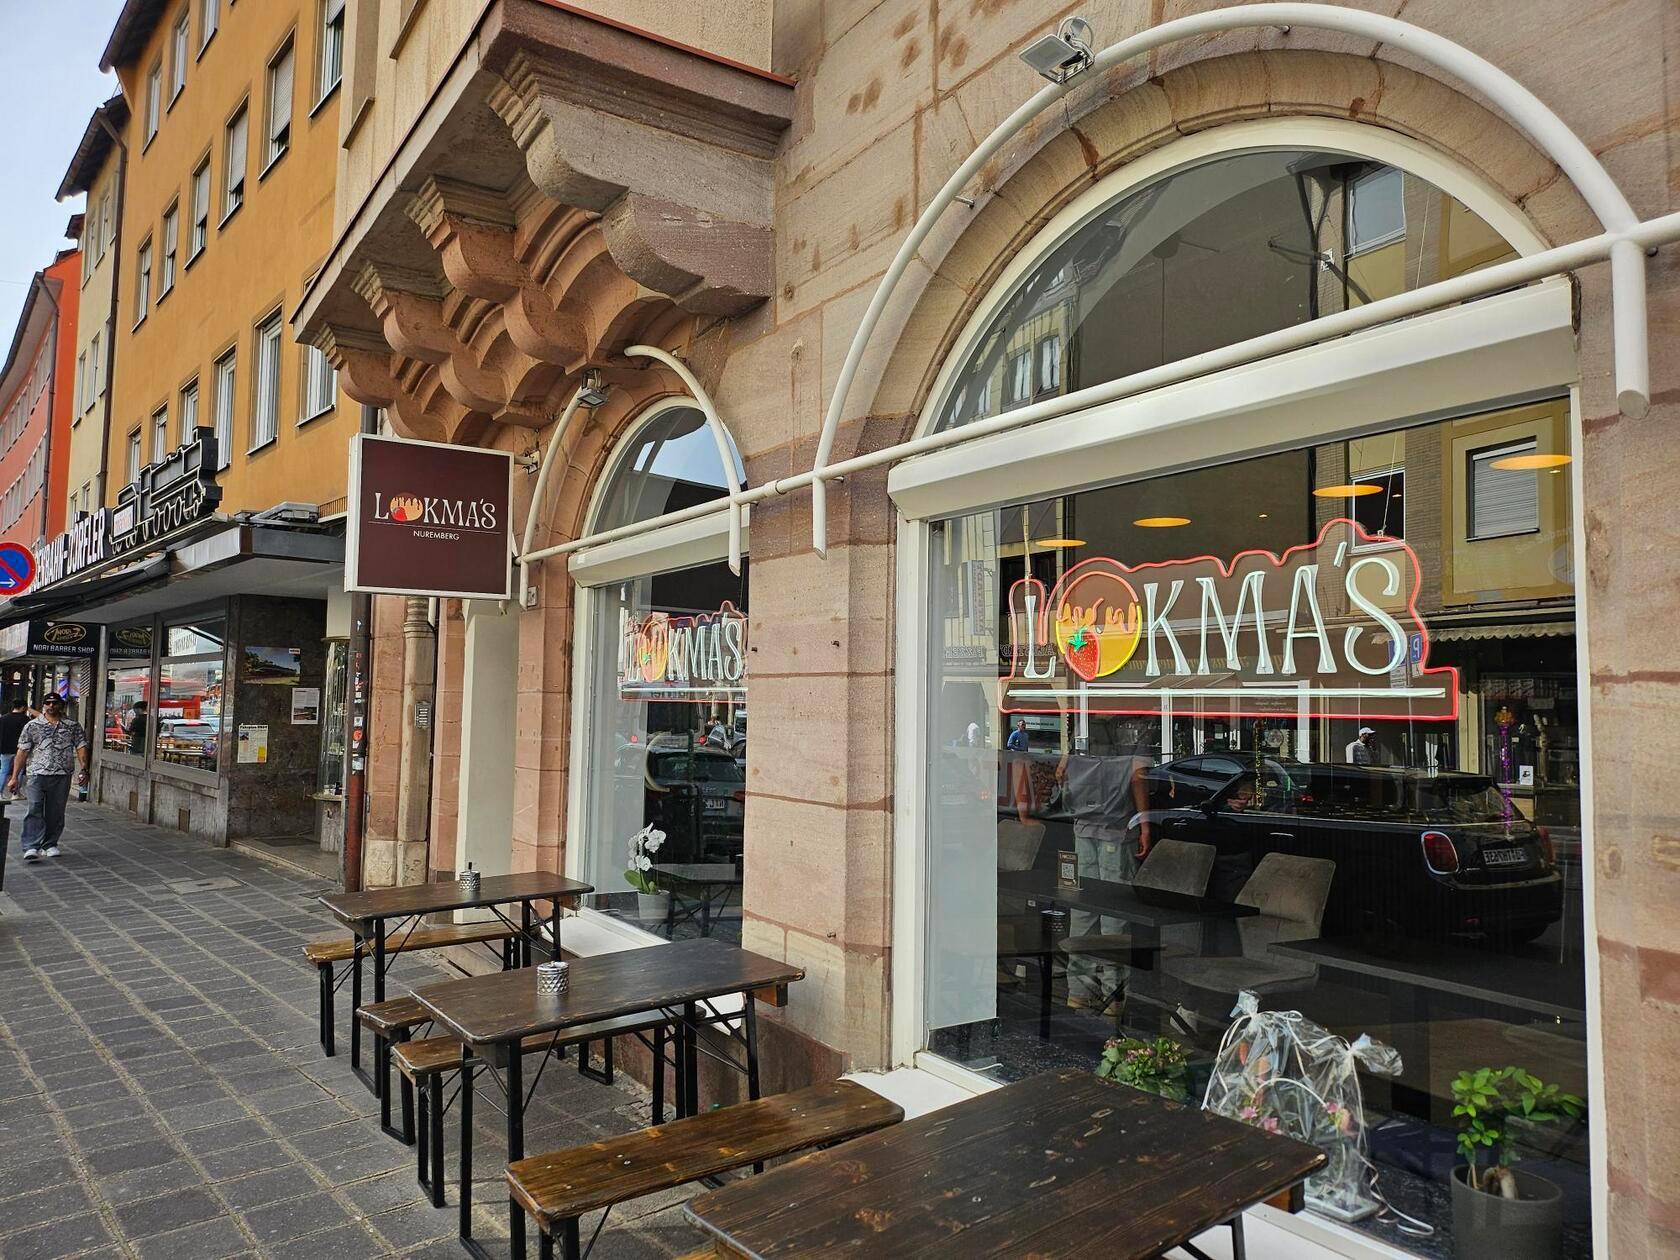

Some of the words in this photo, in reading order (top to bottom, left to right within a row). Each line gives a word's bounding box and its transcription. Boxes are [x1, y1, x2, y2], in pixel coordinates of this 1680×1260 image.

[413, 530, 460, 541] NUREMBERG
[33, 643, 49, 652] NORI
[50, 645, 77, 653] BARBER
[78, 646, 95, 654] SHOP
